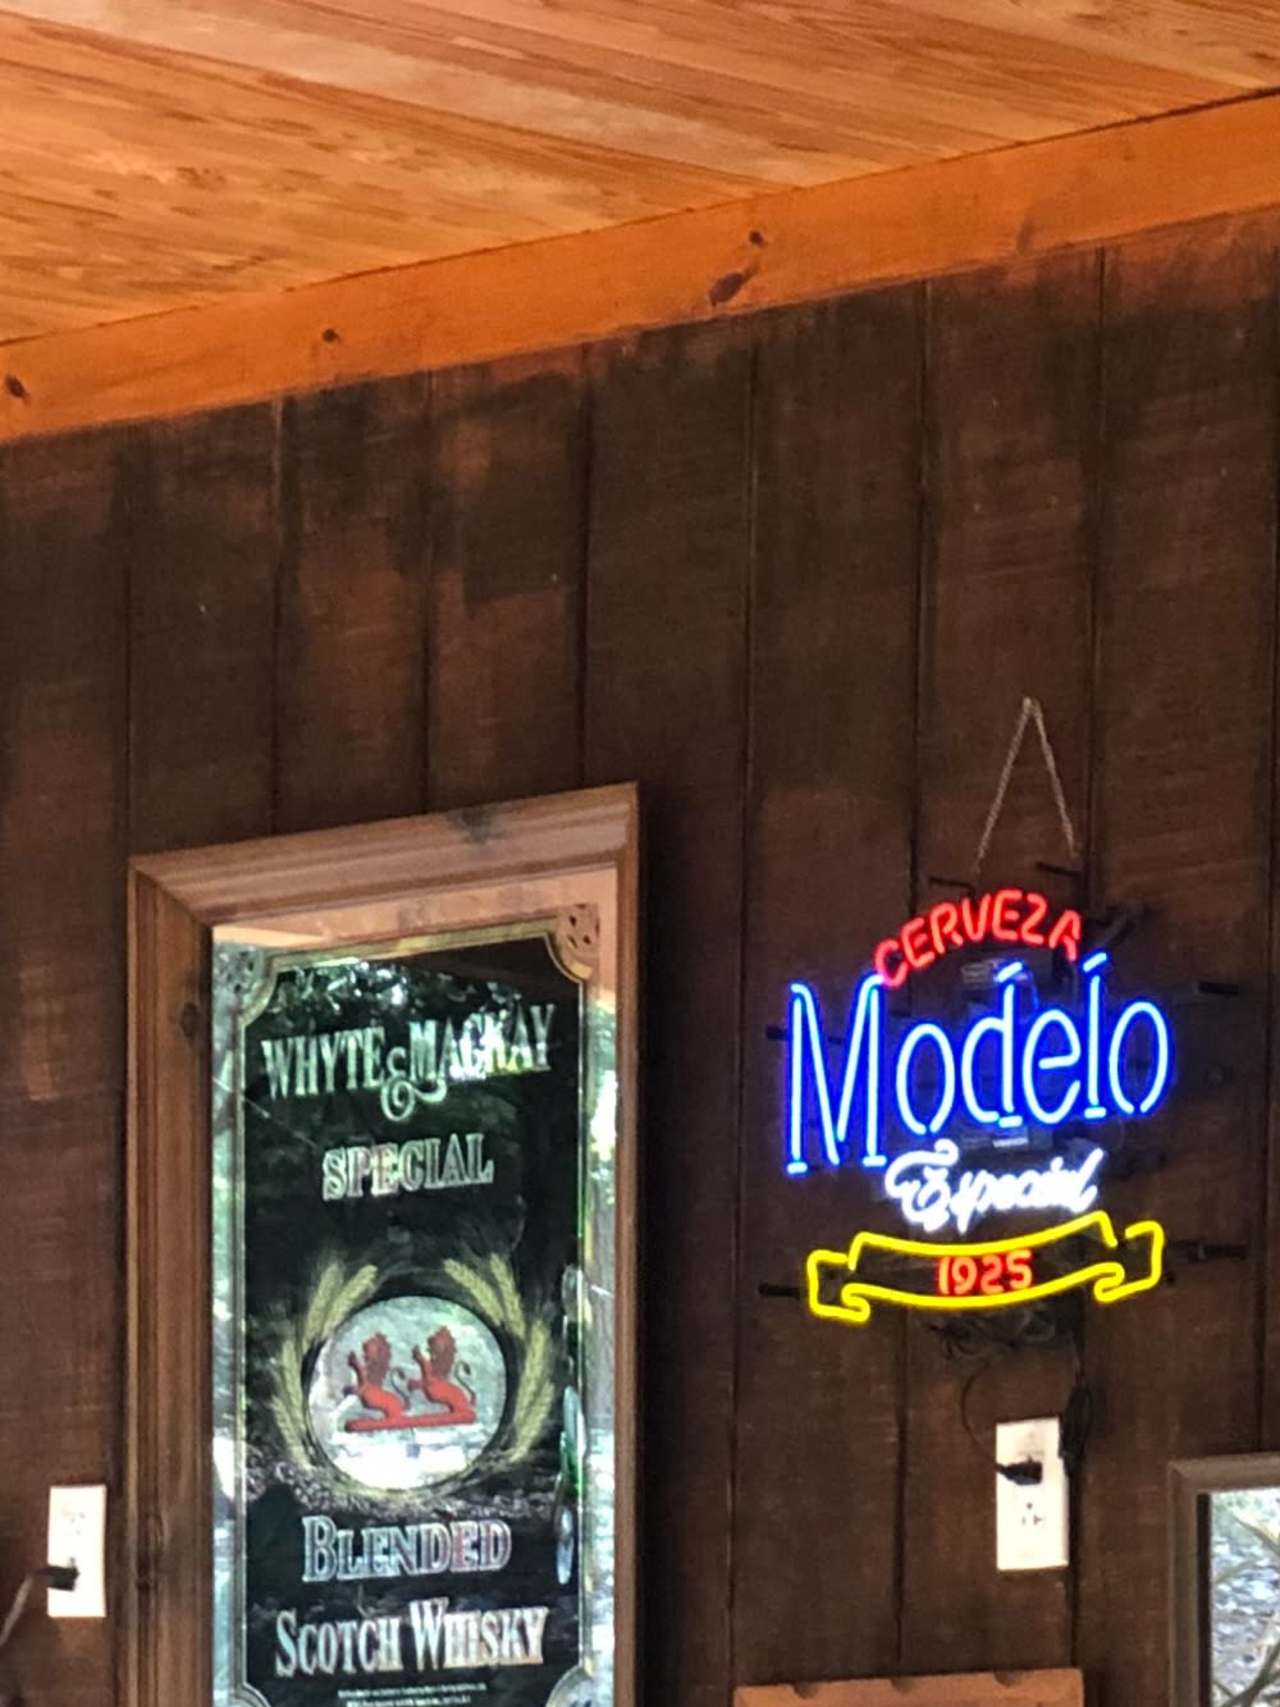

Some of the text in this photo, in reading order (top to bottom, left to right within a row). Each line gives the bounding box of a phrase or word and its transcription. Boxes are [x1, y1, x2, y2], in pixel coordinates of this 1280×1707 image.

[874, 889, 1082, 987] CERVEZA
[261, 1004, 555, 1121] WHYTE & MACKAY
[787, 952, 1168, 1174] Modelo
[323, 1133, 495, 1201] SPECIAL
[938, 1249, 1034, 1296] 1925
